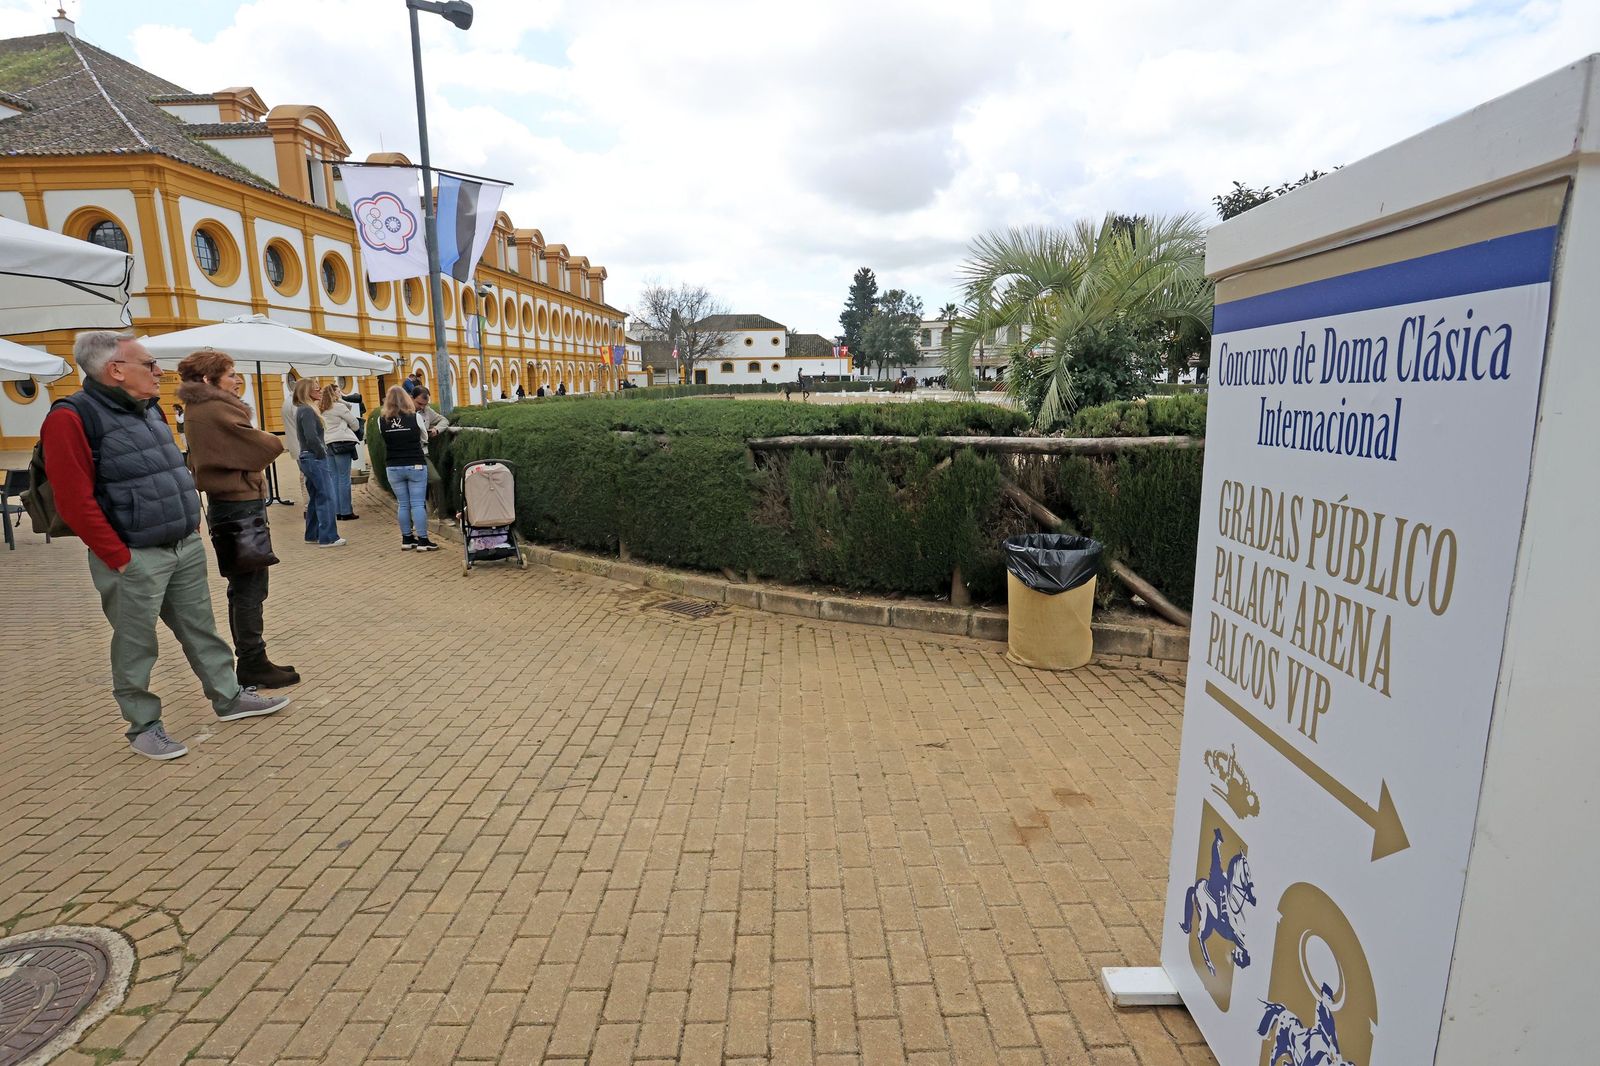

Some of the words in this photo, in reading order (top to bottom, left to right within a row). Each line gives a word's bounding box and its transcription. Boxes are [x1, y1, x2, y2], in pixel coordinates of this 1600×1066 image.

[1218, 341, 1288, 387] Concurso
[1292, 331, 1317, 385] de
[1319, 327, 1389, 385] Doma
[1396, 308, 1512, 383] Clásica
[1257, 396, 1402, 462] Internacional
[1218, 479, 1304, 563] GRADAS
[1305, 493, 1458, 617] PÚBLICO
[1206, 610, 1280, 710] PALCOS
[1286, 655, 1332, 744] VIP
[1211, 545, 1290, 639] PALACE
[1289, 580, 1393, 699] ARENA
